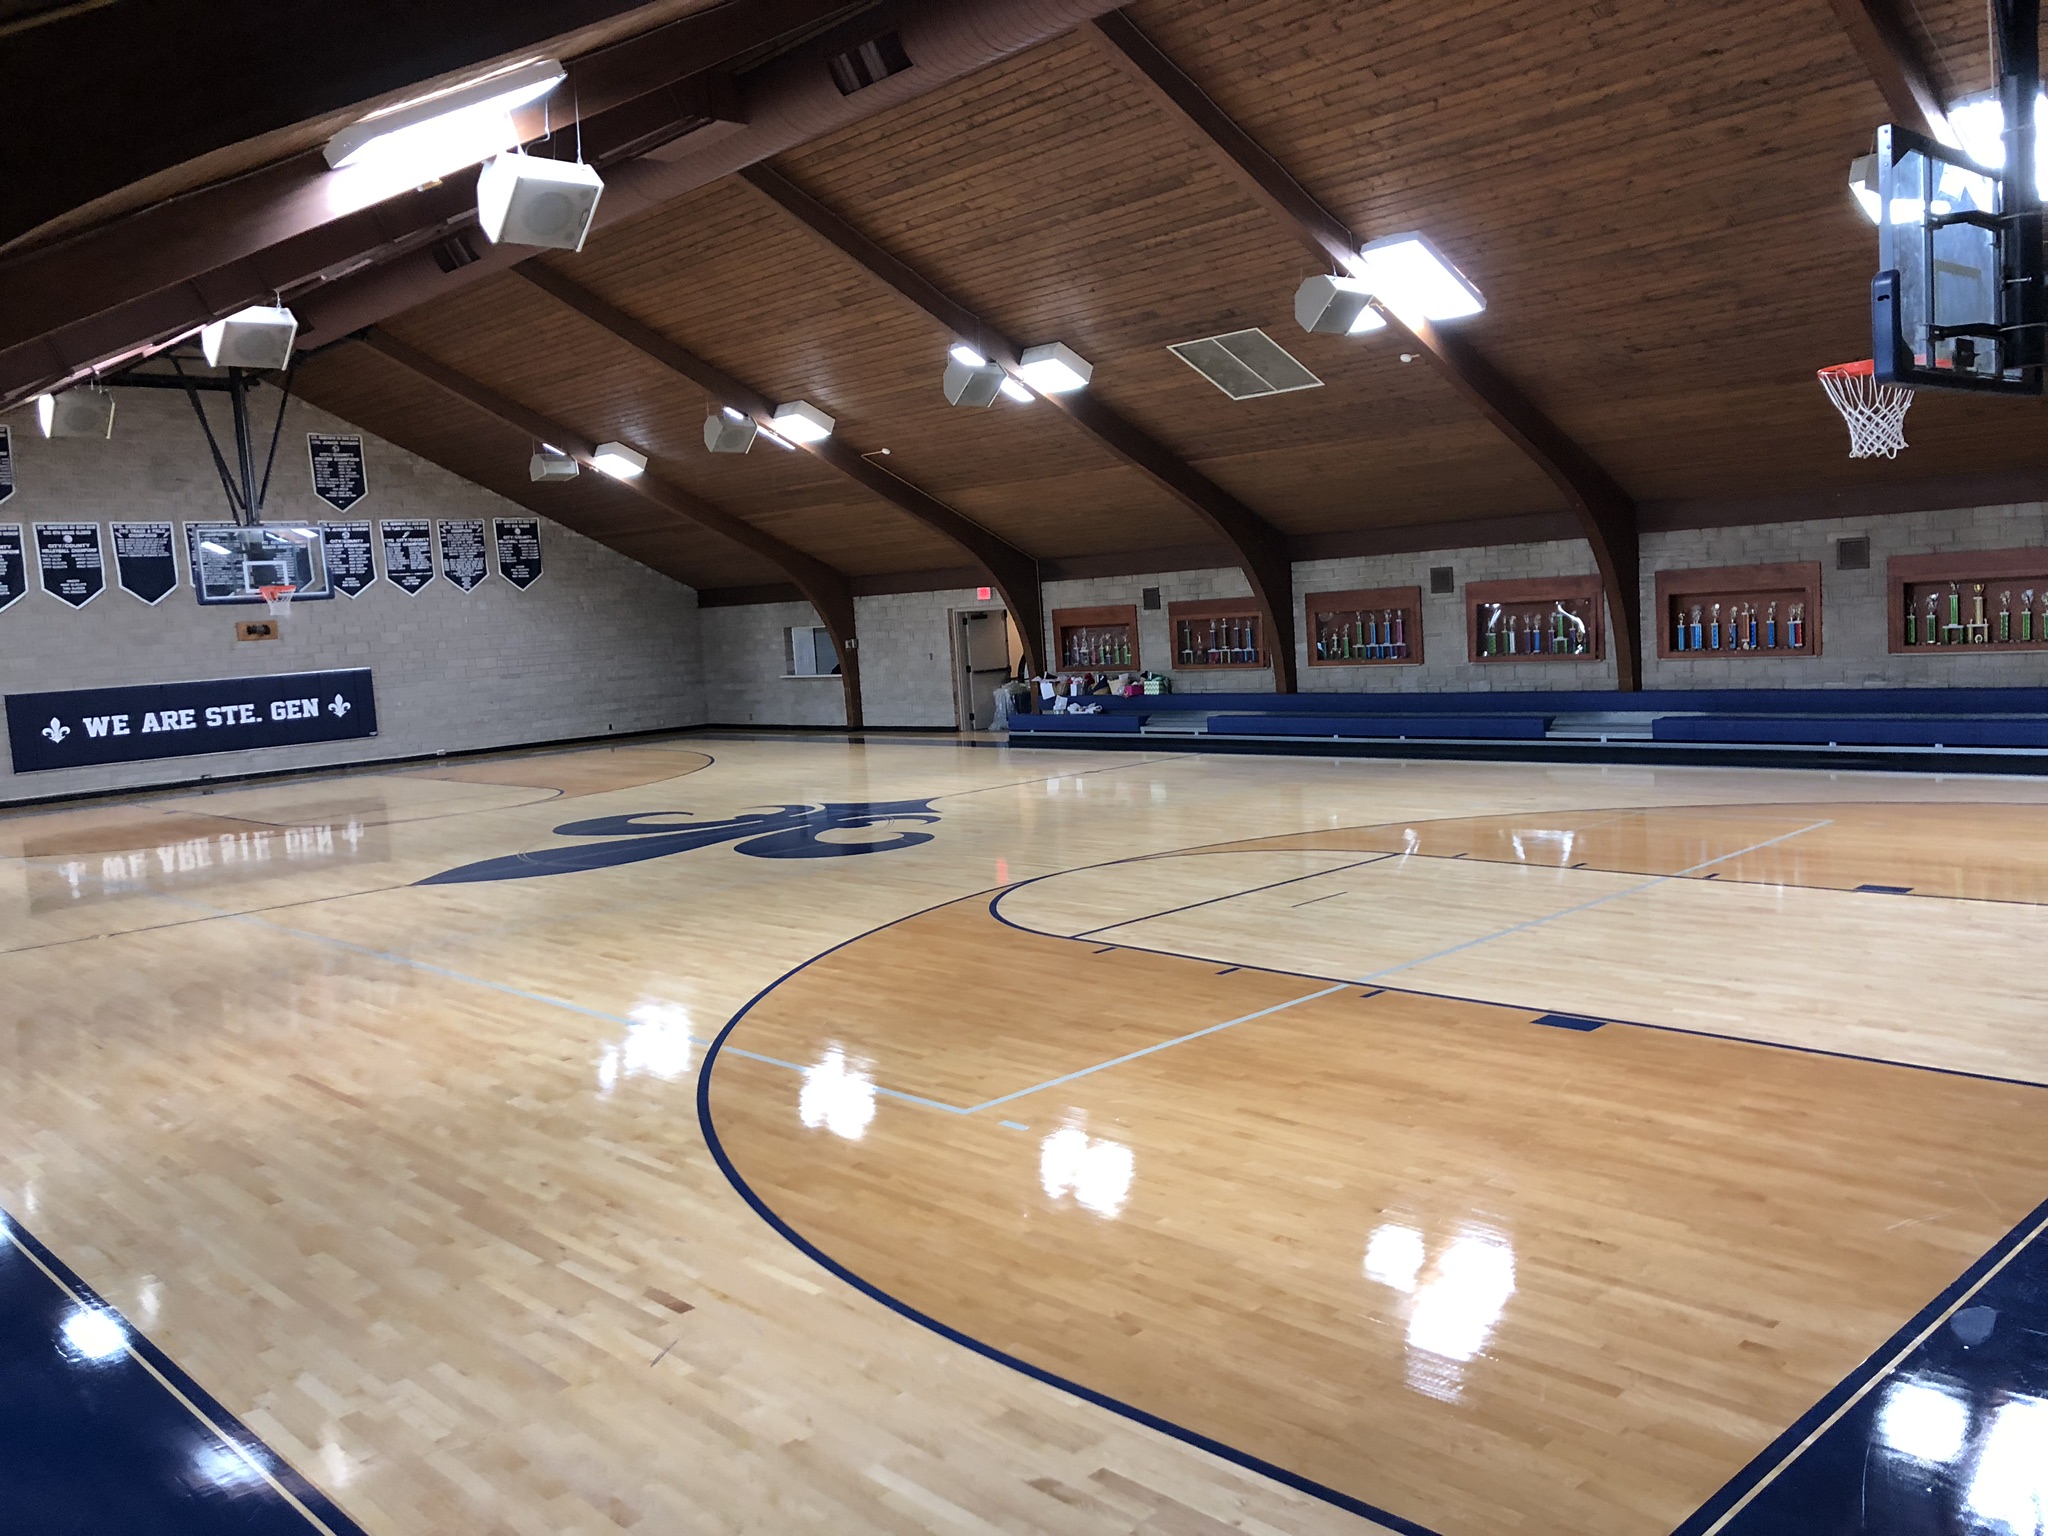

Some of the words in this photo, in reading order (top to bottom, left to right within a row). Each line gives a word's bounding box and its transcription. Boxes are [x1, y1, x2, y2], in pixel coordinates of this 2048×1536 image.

[82, 714, 131, 738] WE
[141, 708, 198, 733] ARE
[205, 703, 263, 727] STE.
[270, 697, 320, 721] GEN
